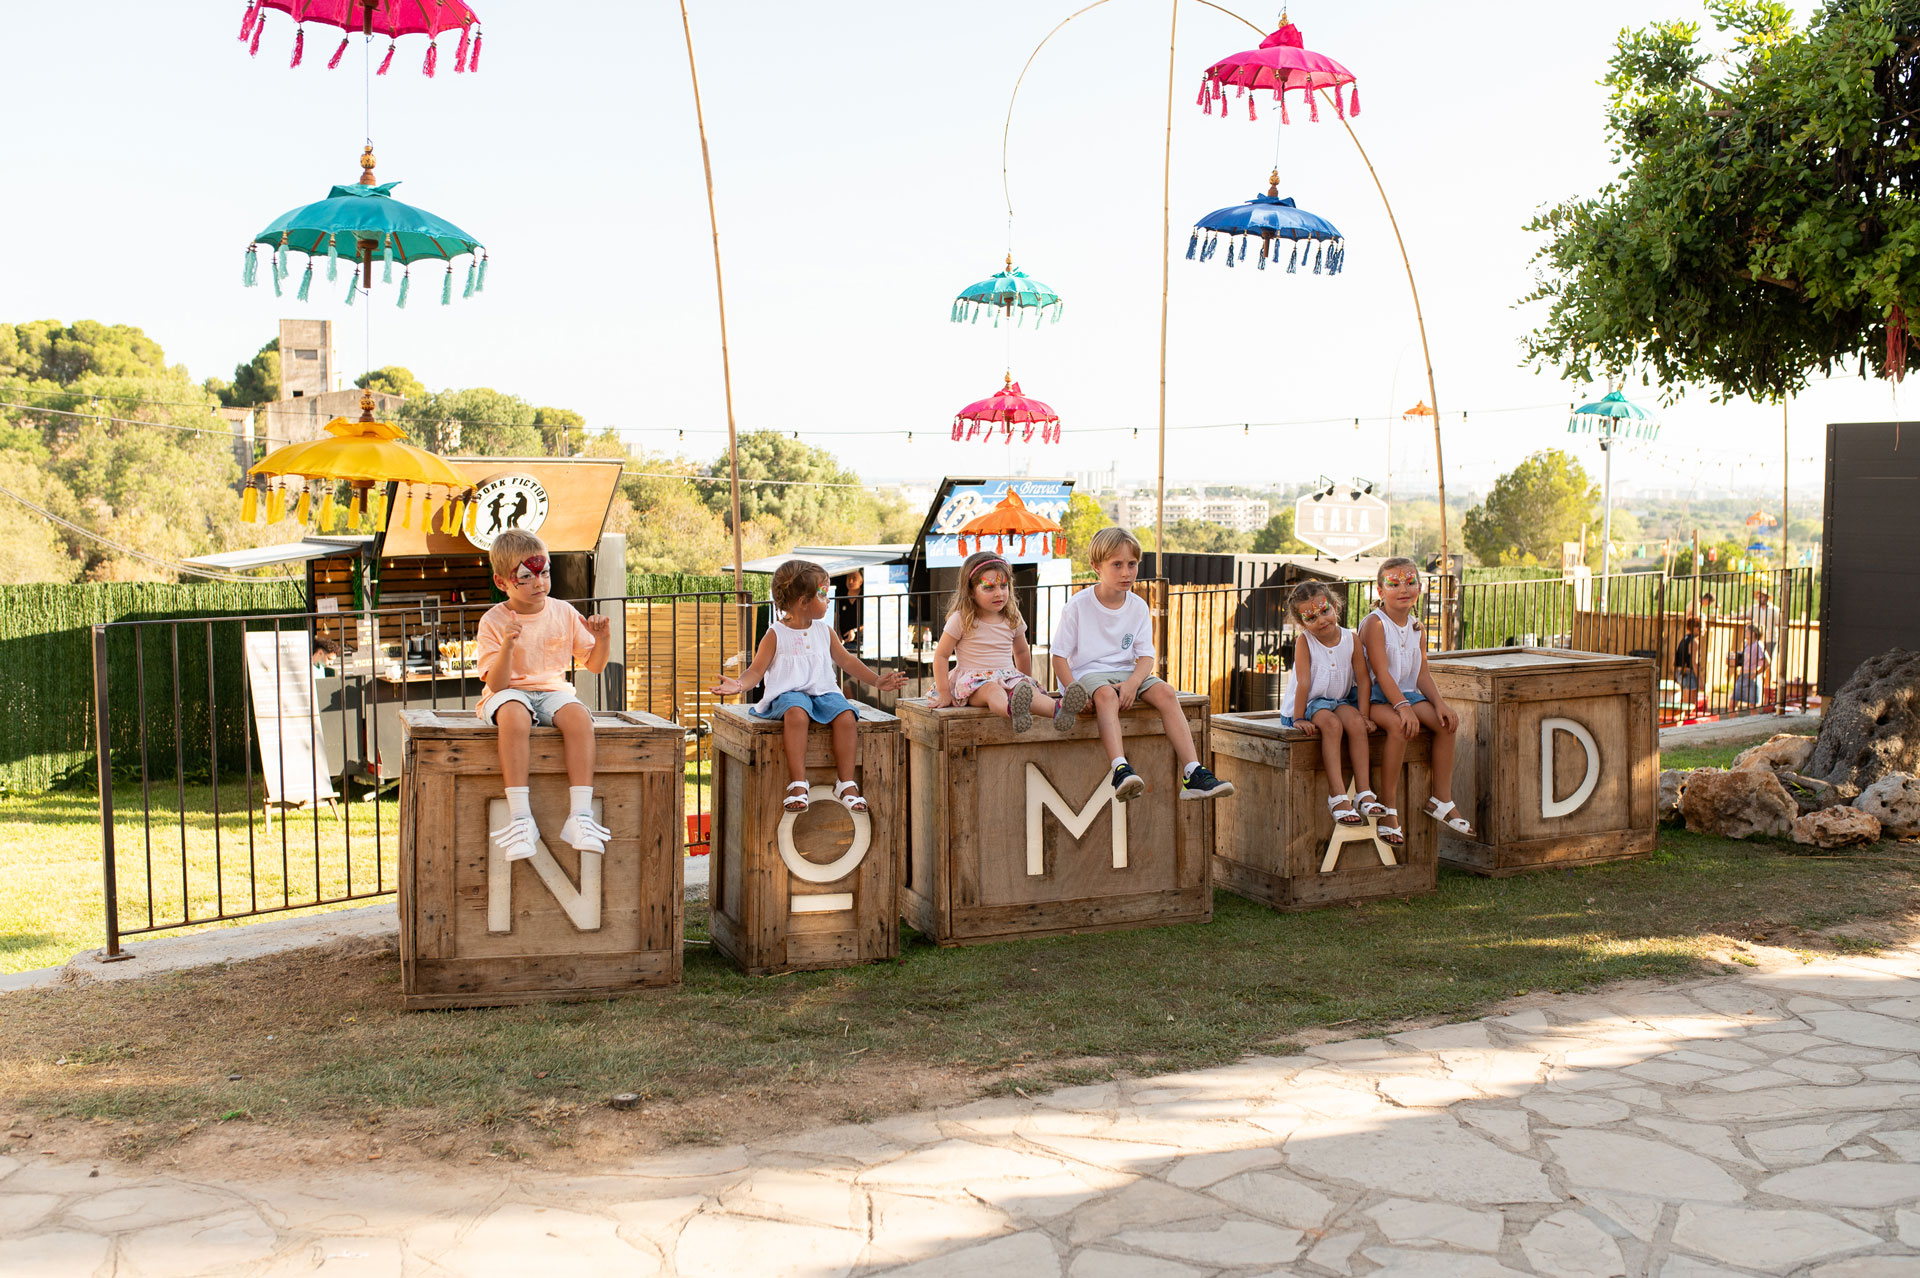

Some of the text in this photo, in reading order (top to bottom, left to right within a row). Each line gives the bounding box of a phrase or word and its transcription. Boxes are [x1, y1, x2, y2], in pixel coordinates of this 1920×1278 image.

[477, 477, 547, 503] PORK FICTION
[1019, 480, 1061, 495] Bravas
[1313, 506, 1370, 533] GALA
